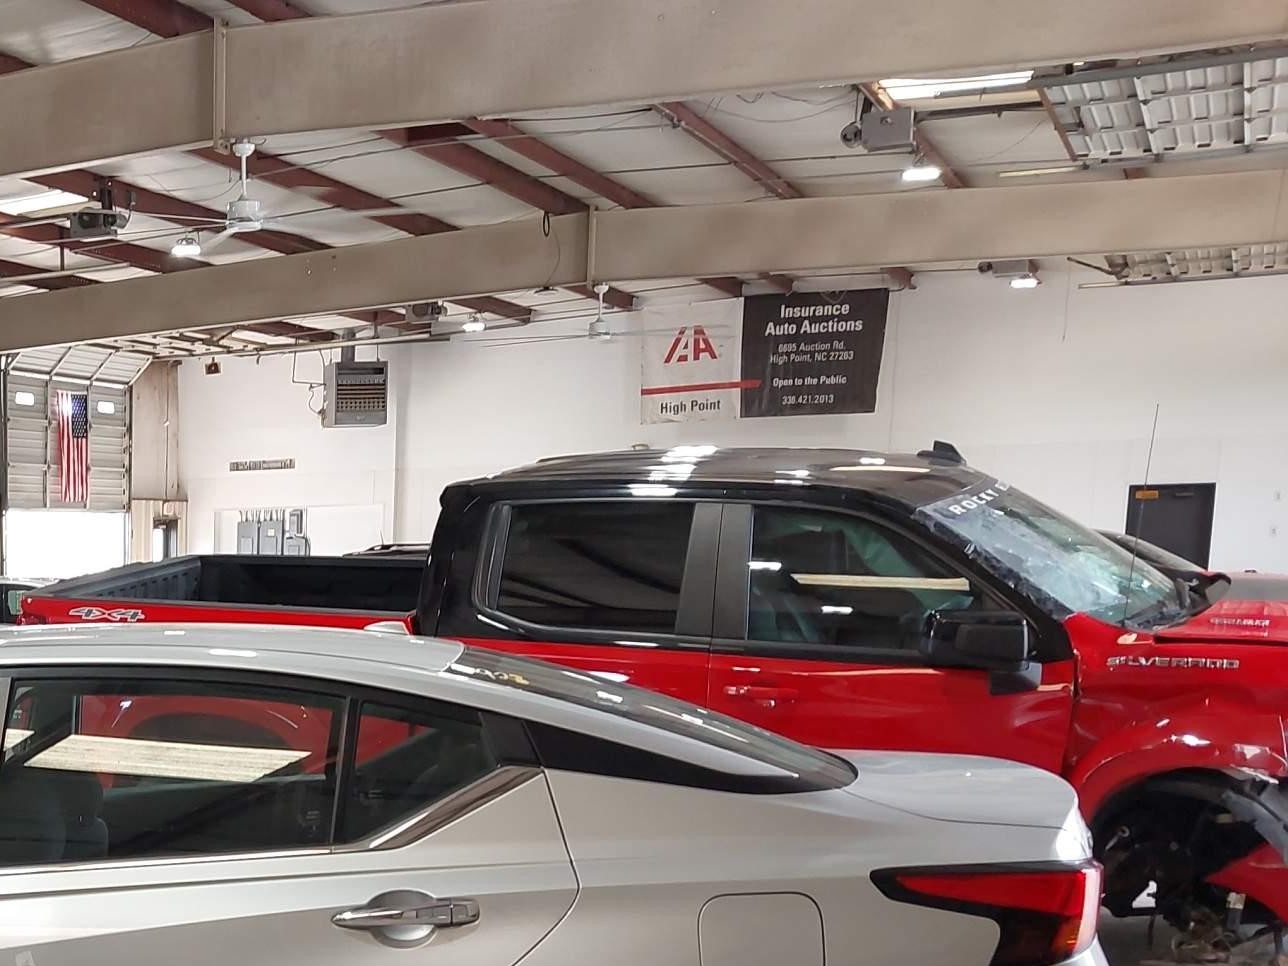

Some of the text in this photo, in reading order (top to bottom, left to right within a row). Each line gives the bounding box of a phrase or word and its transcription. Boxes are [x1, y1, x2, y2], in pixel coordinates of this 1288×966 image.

[780, 304, 850, 319] Insurance
[765, 318, 864, 337] Auto Auctions
[798, 342, 831, 352] Auction
[770, 354, 788, 366] High
[814, 352, 828, 362] NC
[772, 374, 847, 389] Open to the Public
[660, 398, 721, 415] High Point
[1106, 655, 1240, 670] SILVERADO
